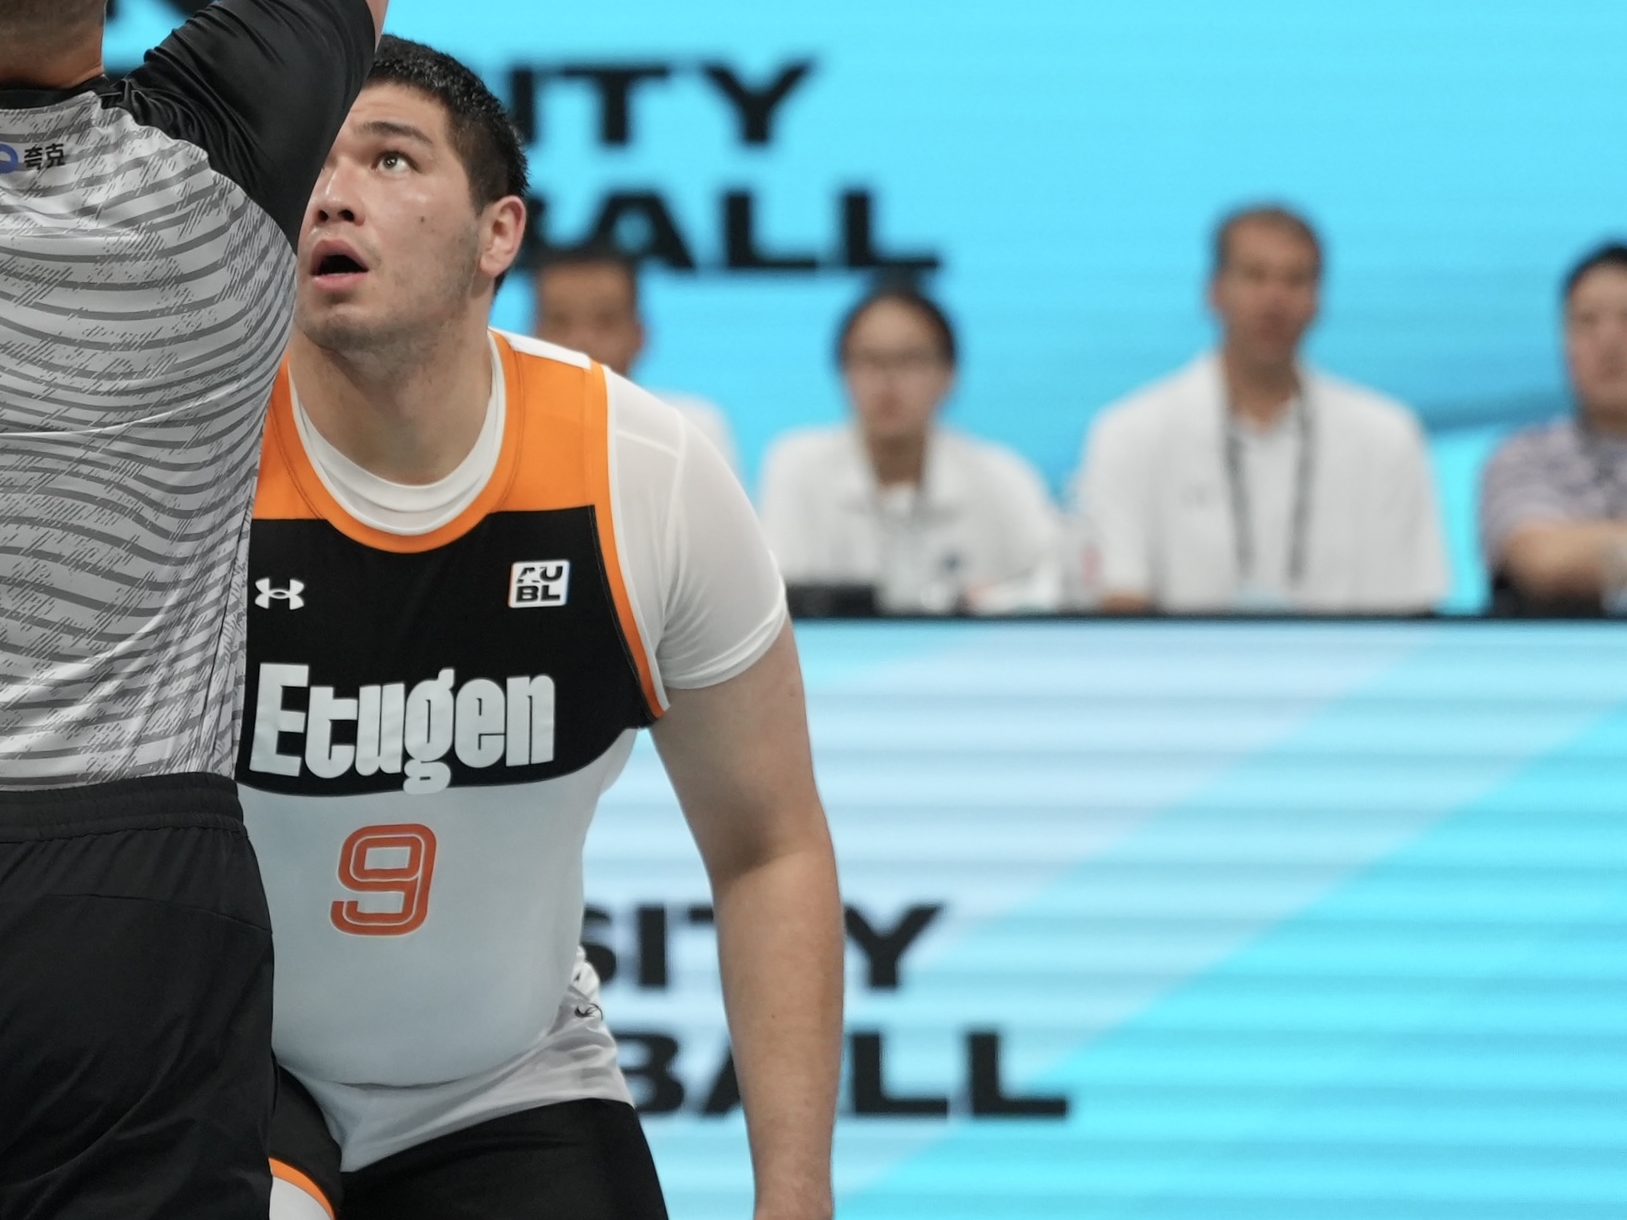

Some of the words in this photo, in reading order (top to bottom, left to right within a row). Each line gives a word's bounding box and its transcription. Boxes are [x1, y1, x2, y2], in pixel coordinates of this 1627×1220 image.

[24, 143, 66, 171] 夸克
[515, 584, 562, 603] BL
[249, 663, 555, 795] Etugen
[330, 823, 437, 936] 9
